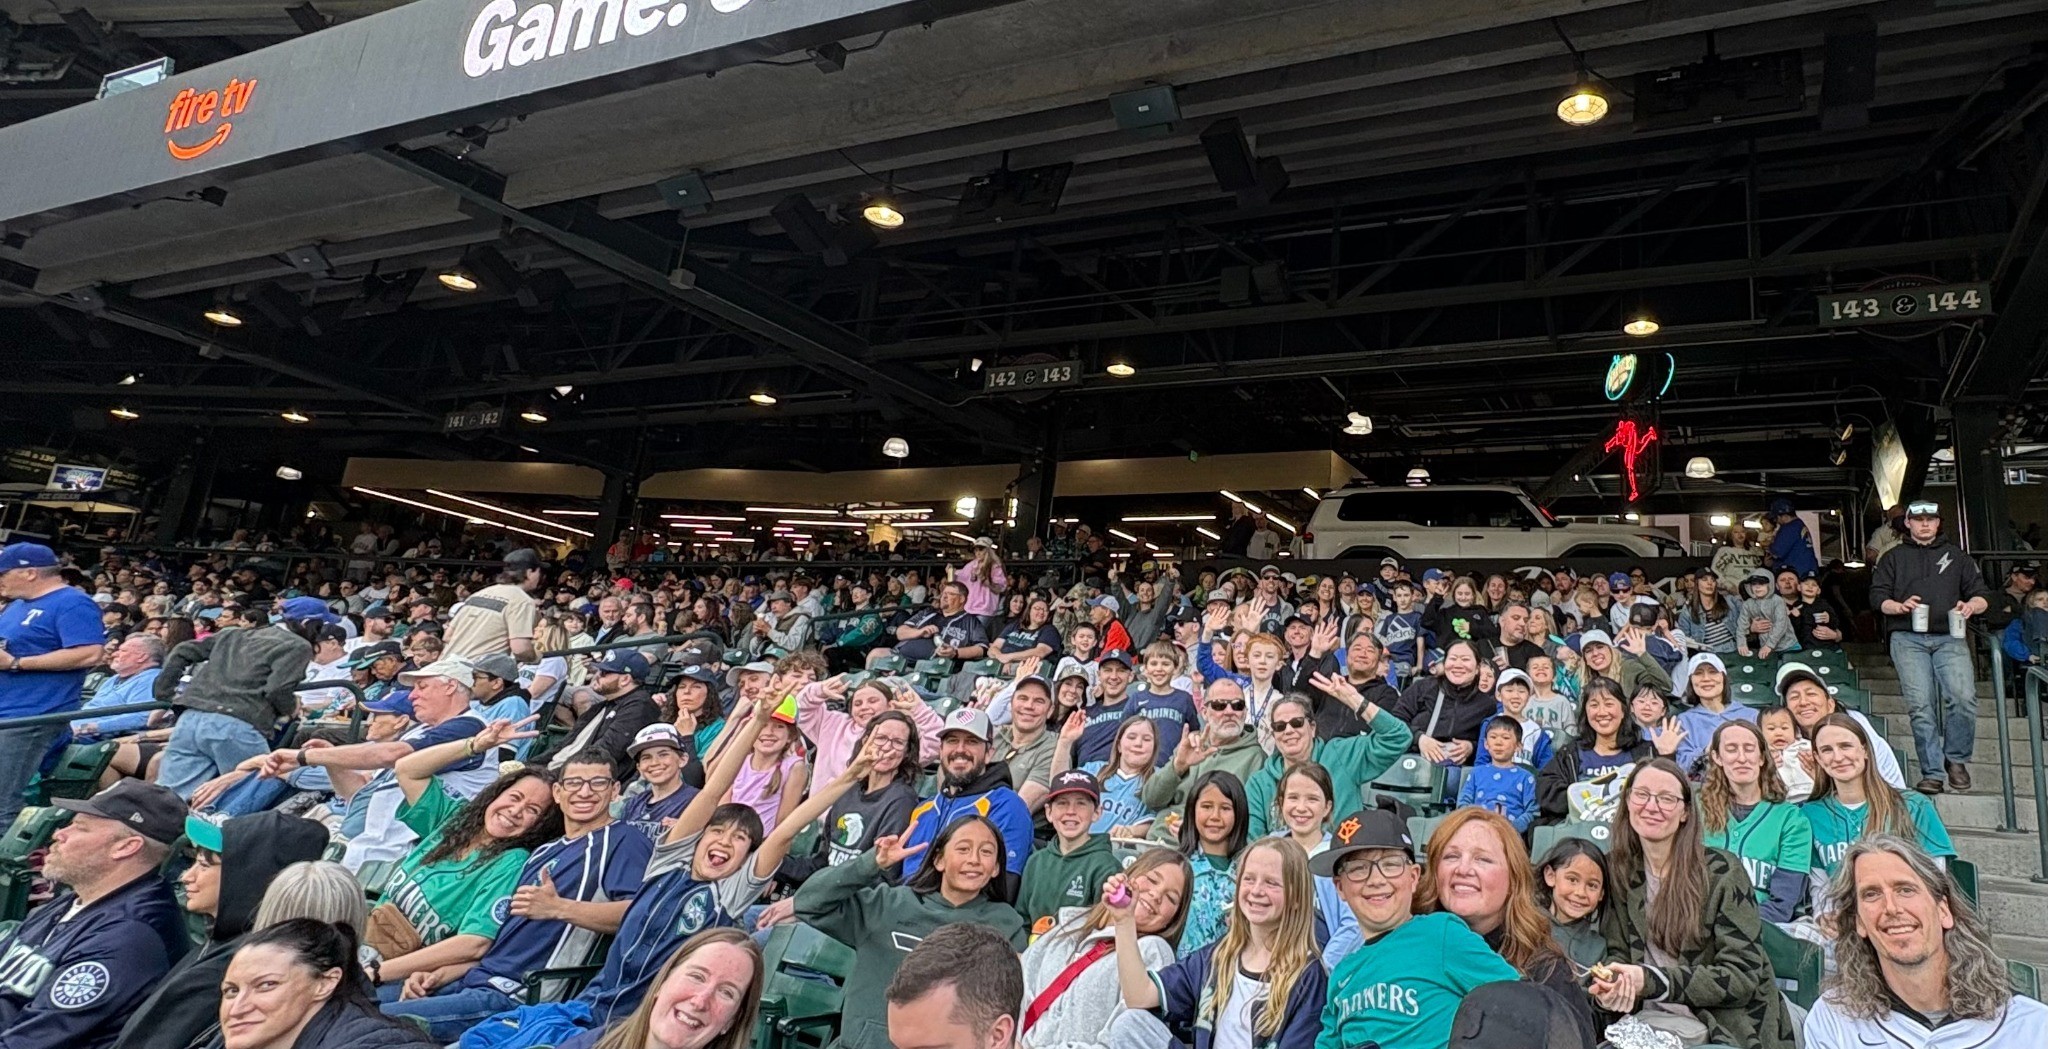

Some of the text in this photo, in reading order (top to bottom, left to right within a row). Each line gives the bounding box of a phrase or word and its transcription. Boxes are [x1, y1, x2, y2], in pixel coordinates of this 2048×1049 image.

[463, 0, 688, 78] Game.
[165, 79, 258, 132] fire tv
[1831, 290, 1981, 320] 143 & 144
[989, 366, 1071, 387] 142 & 143
[448, 415, 465, 428] 141
[480, 412, 498, 425] 142
[20, 608, 44, 626] T
